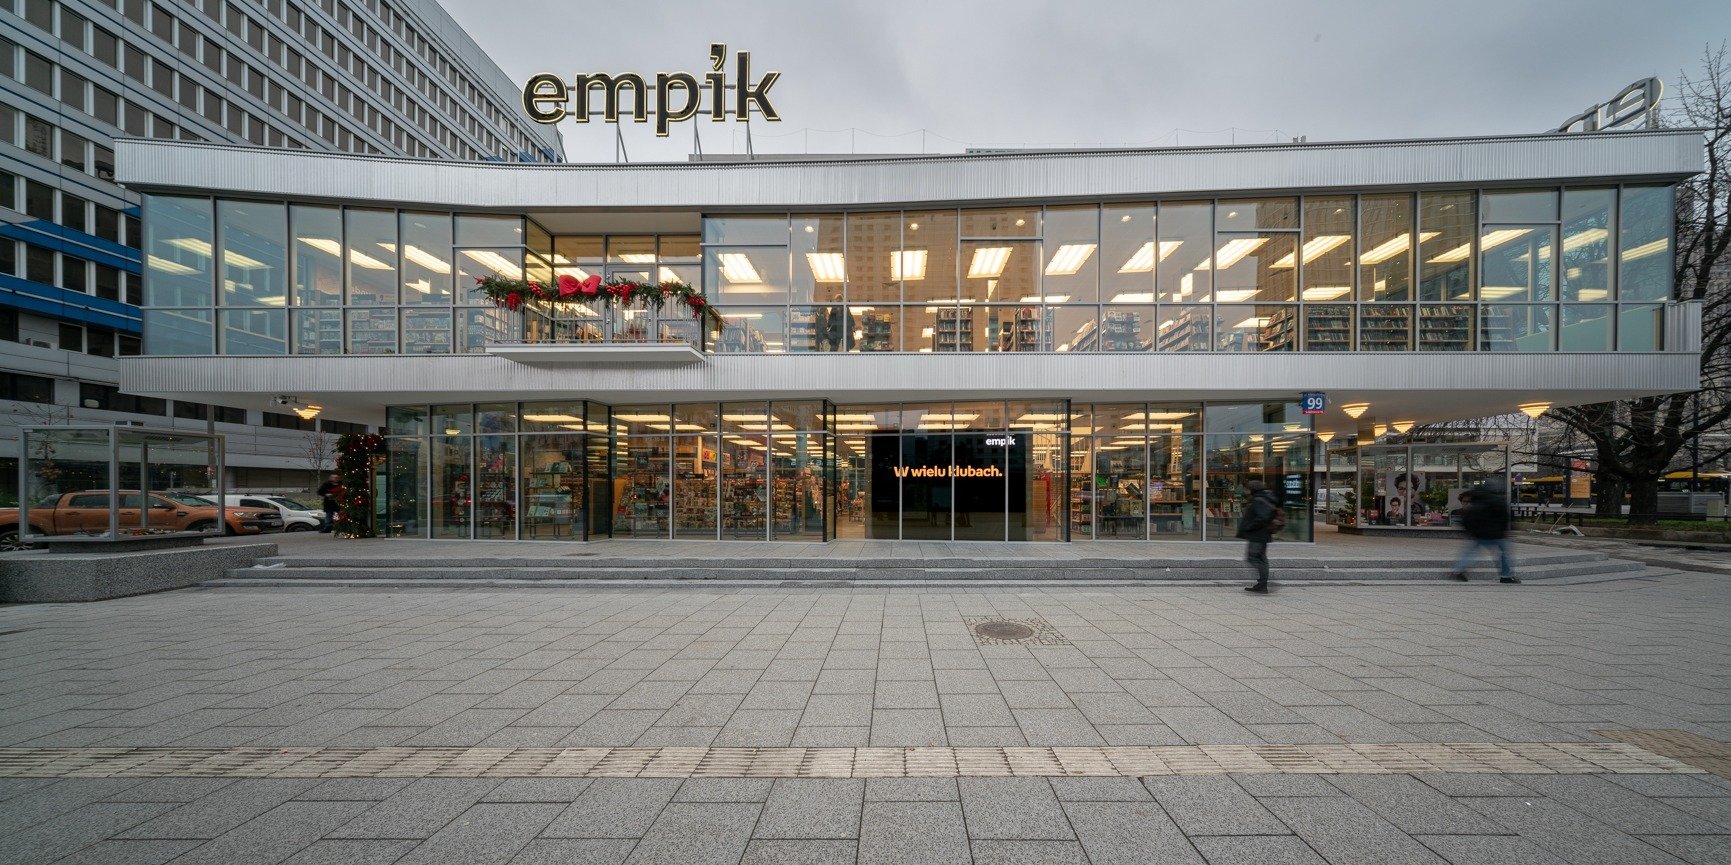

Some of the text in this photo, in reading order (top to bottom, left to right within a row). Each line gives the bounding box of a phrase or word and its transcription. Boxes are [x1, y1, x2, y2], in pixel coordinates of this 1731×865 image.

[522, 43, 781, 137] empik
[1307, 397, 1323, 410] 99
[985, 436, 1016, 447] empik
[893, 465, 1003, 477] W wielu klubach.
